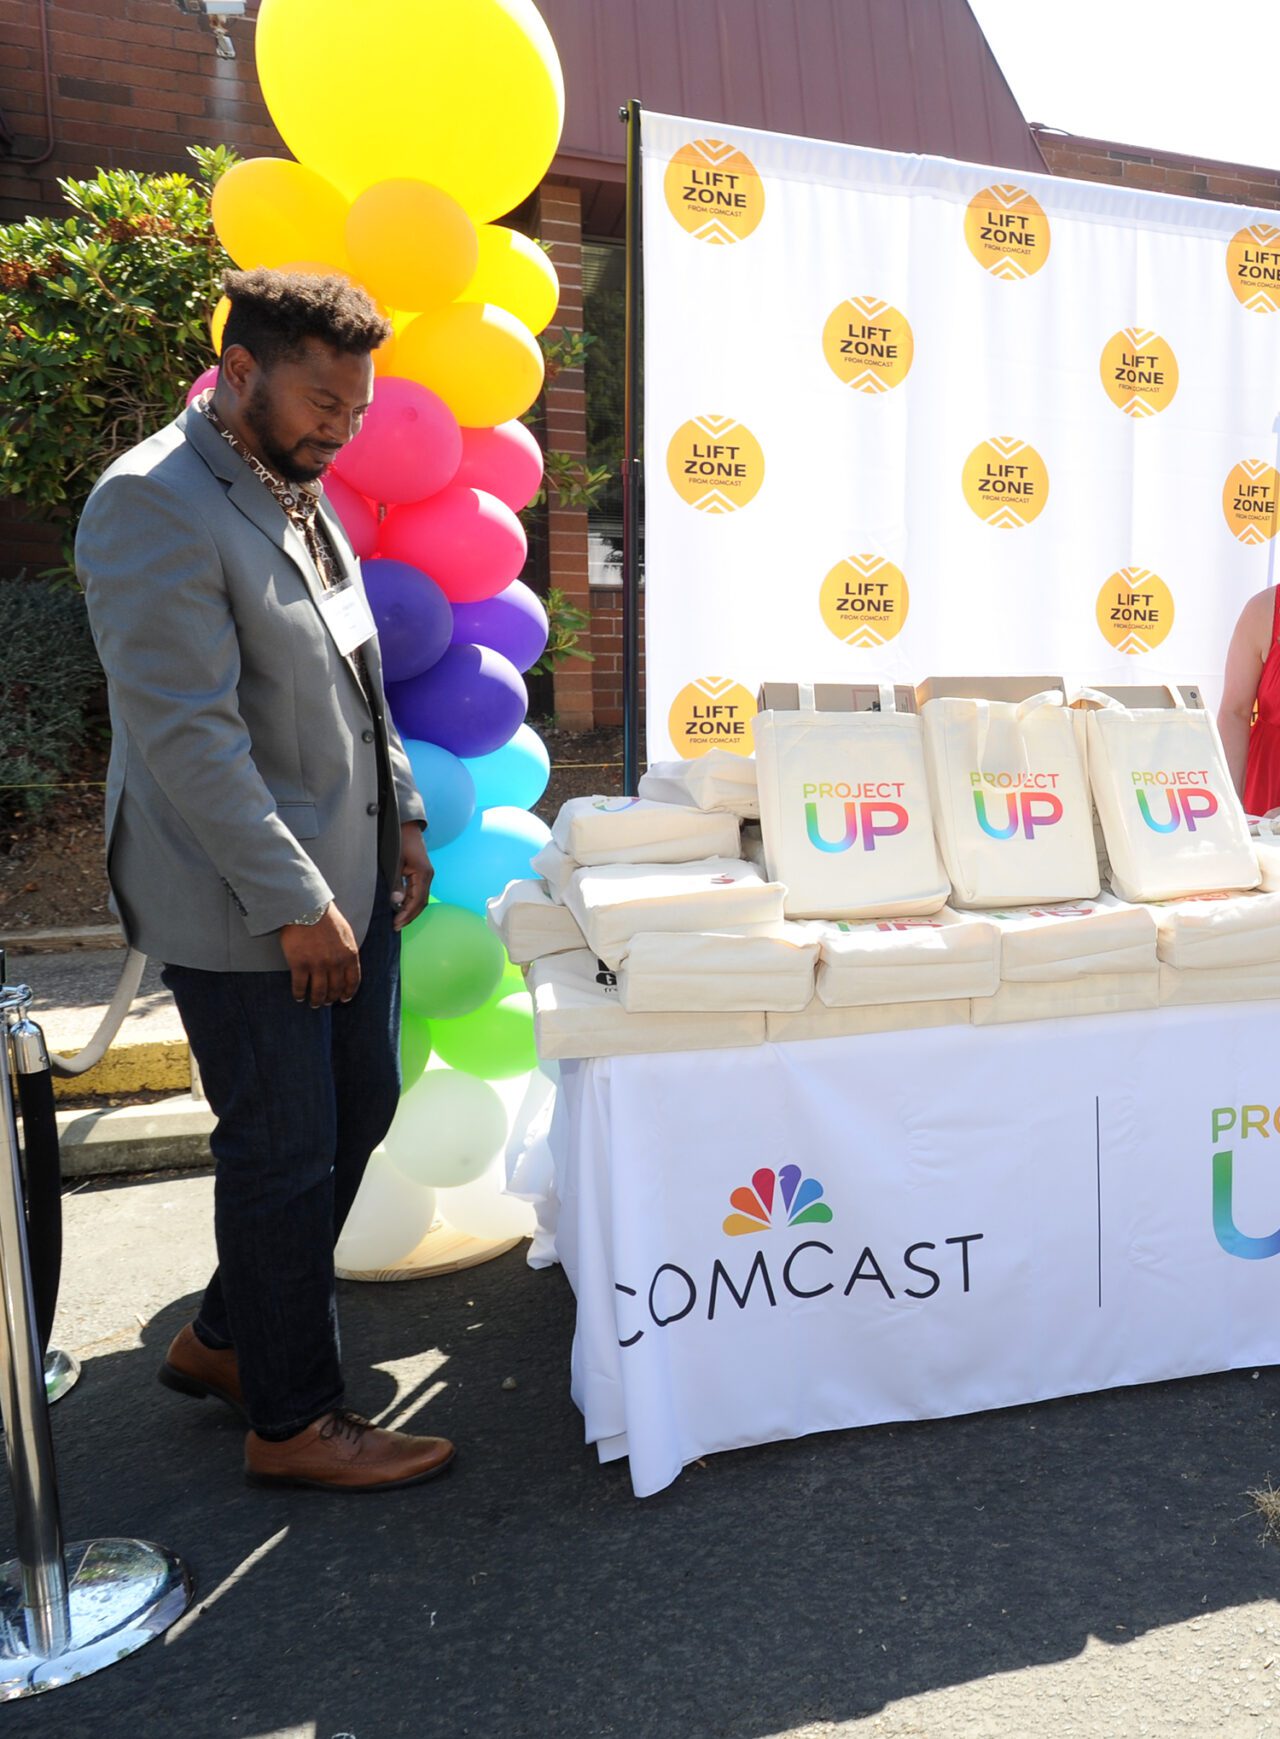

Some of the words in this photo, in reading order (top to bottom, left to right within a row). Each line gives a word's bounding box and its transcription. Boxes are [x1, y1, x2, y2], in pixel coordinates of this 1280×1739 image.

[692, 169, 739, 190] LIFT
[682, 187, 746, 208] ZONE
[687, 204, 708, 214] FROM
[710, 206, 742, 217] COMCAST
[988, 212, 1029, 230] LIFT
[980, 227, 1036, 247] ZONE
[984, 243, 1002, 252] FROM
[1003, 245, 1032, 255] COMCAST
[1240, 280, 1256, 288] FROM
[848, 324, 891, 342] LIFT
[840, 340, 898, 358] ZONE
[844, 356, 862, 366] FROM
[864, 358, 894, 368] COMCAST
[1122, 352, 1158, 370] LIFT
[1114, 368, 1164, 386] ZONE
[1134, 385, 1160, 394] COMCAST
[692, 444, 740, 460] LIFT
[684, 460, 746, 478] ZONE
[986, 464, 1028, 480] LIFT
[688, 478, 708, 486] FROM
[710, 479, 742, 487] COMCAST
[978, 479, 1034, 496] ZONE
[982, 494, 1000, 502] FROM
[1001, 496, 1030, 504] COMCAST
[1238, 484, 1270, 498] LIFT
[1232, 498, 1275, 514] ZONE
[844, 582, 888, 596] LIFT
[836, 598, 894, 612] ZONE
[1118, 594, 1154, 607] LIFT
[860, 614, 890, 622] COMCAST
[1110, 608, 1159, 622] ZONE
[692, 705, 738, 718] LIFT
[685, 721, 745, 734] ZONE
[969, 770, 1061, 790] PROJECT
[1130, 770, 1209, 787] PROJECT
[802, 782, 906, 801] PROJECT
[973, 790, 1064, 840] UP
[1135, 787, 1219, 834] UP
[804, 802, 910, 854] UP
